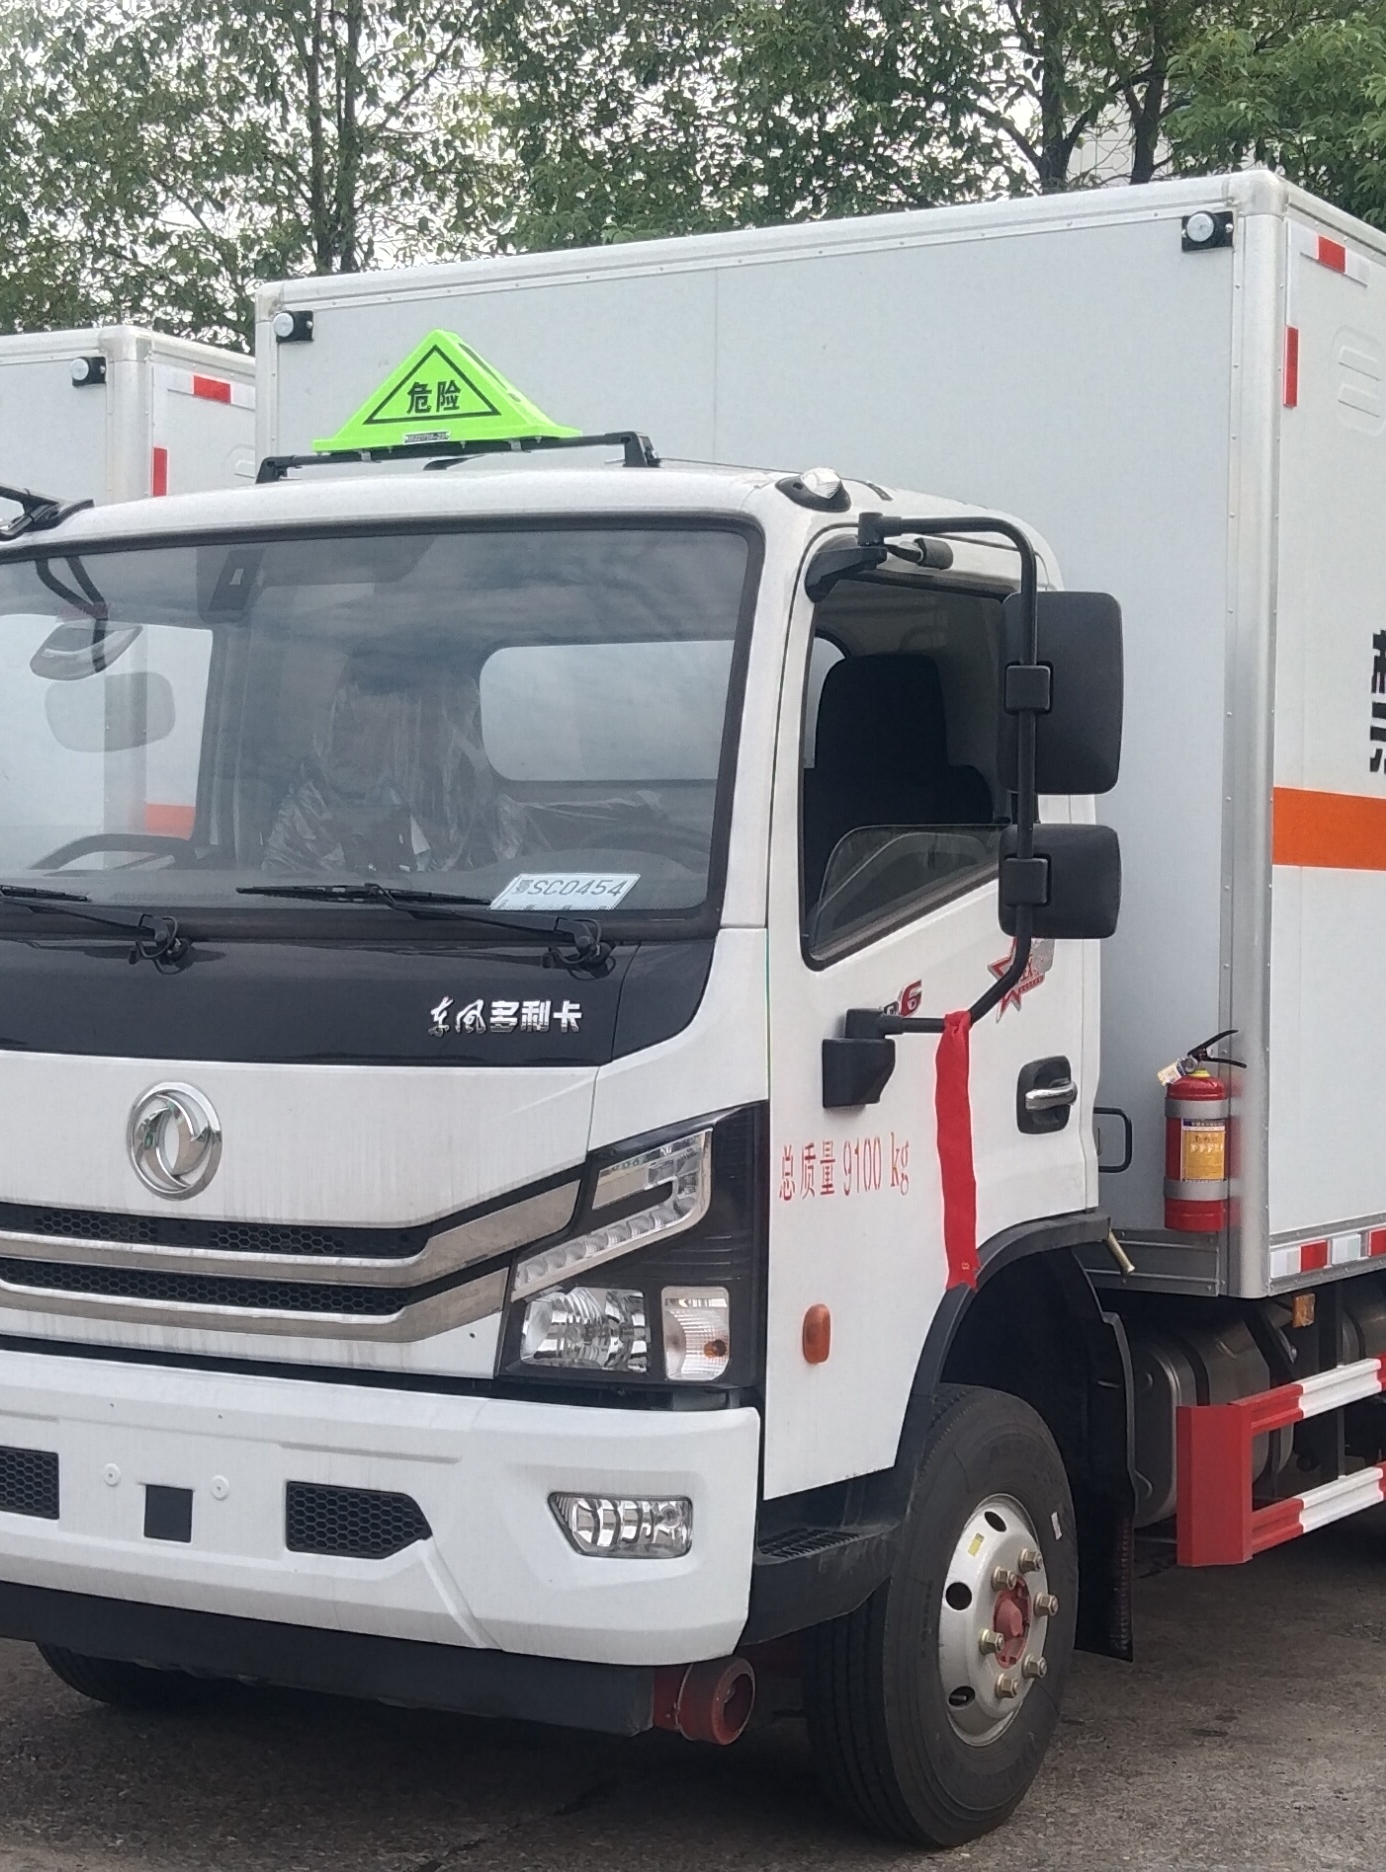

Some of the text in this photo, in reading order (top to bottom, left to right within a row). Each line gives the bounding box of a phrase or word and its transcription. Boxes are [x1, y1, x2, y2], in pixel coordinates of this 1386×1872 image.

[406, 379, 461, 414] 危险
[428, 995, 583, 1038] 东风多利卡
[779, 1131, 909, 1200] 总质量 9100 kg
